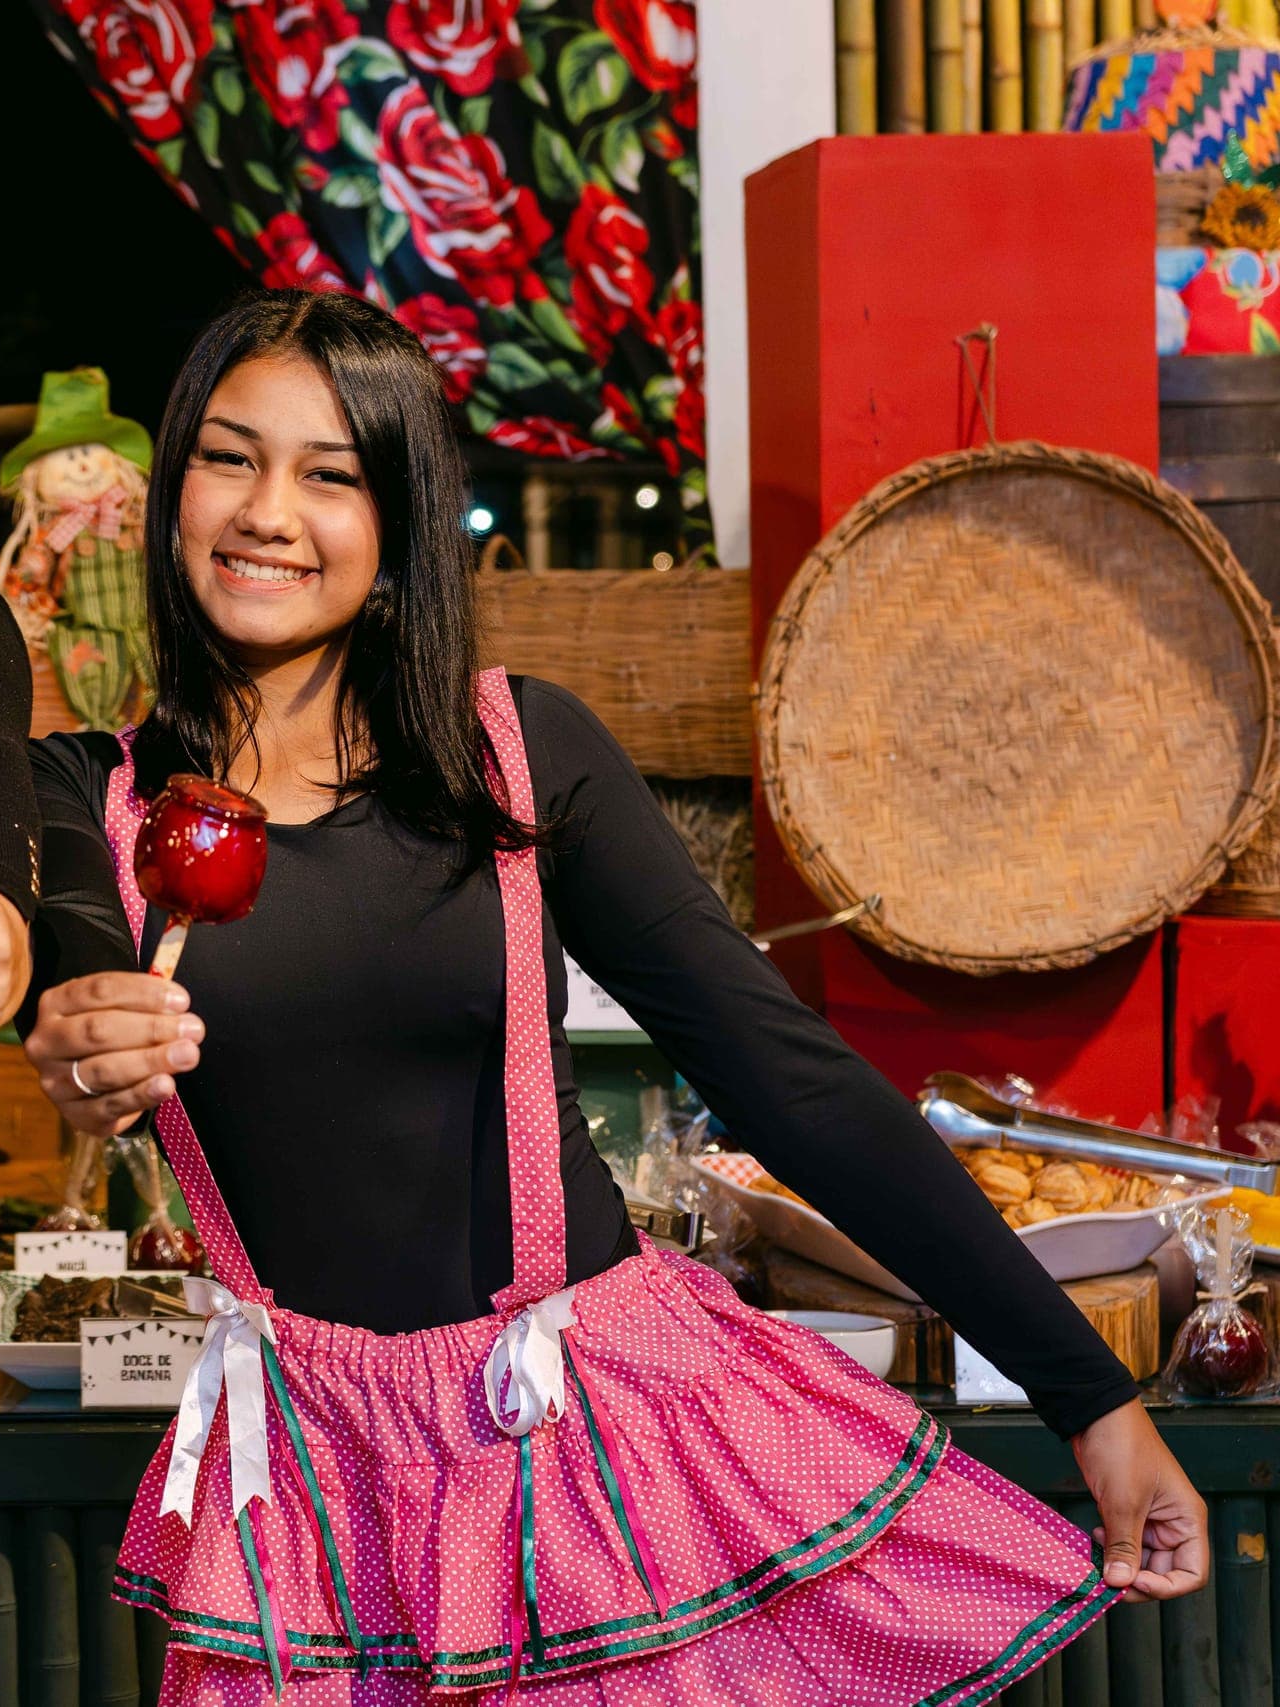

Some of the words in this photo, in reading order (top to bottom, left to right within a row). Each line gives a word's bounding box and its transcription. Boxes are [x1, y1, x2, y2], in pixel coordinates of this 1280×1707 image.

[123, 1354, 153, 1366] DOCE
[158, 1354, 172, 1366] DE
[120, 1369, 172, 1381] BANANA
